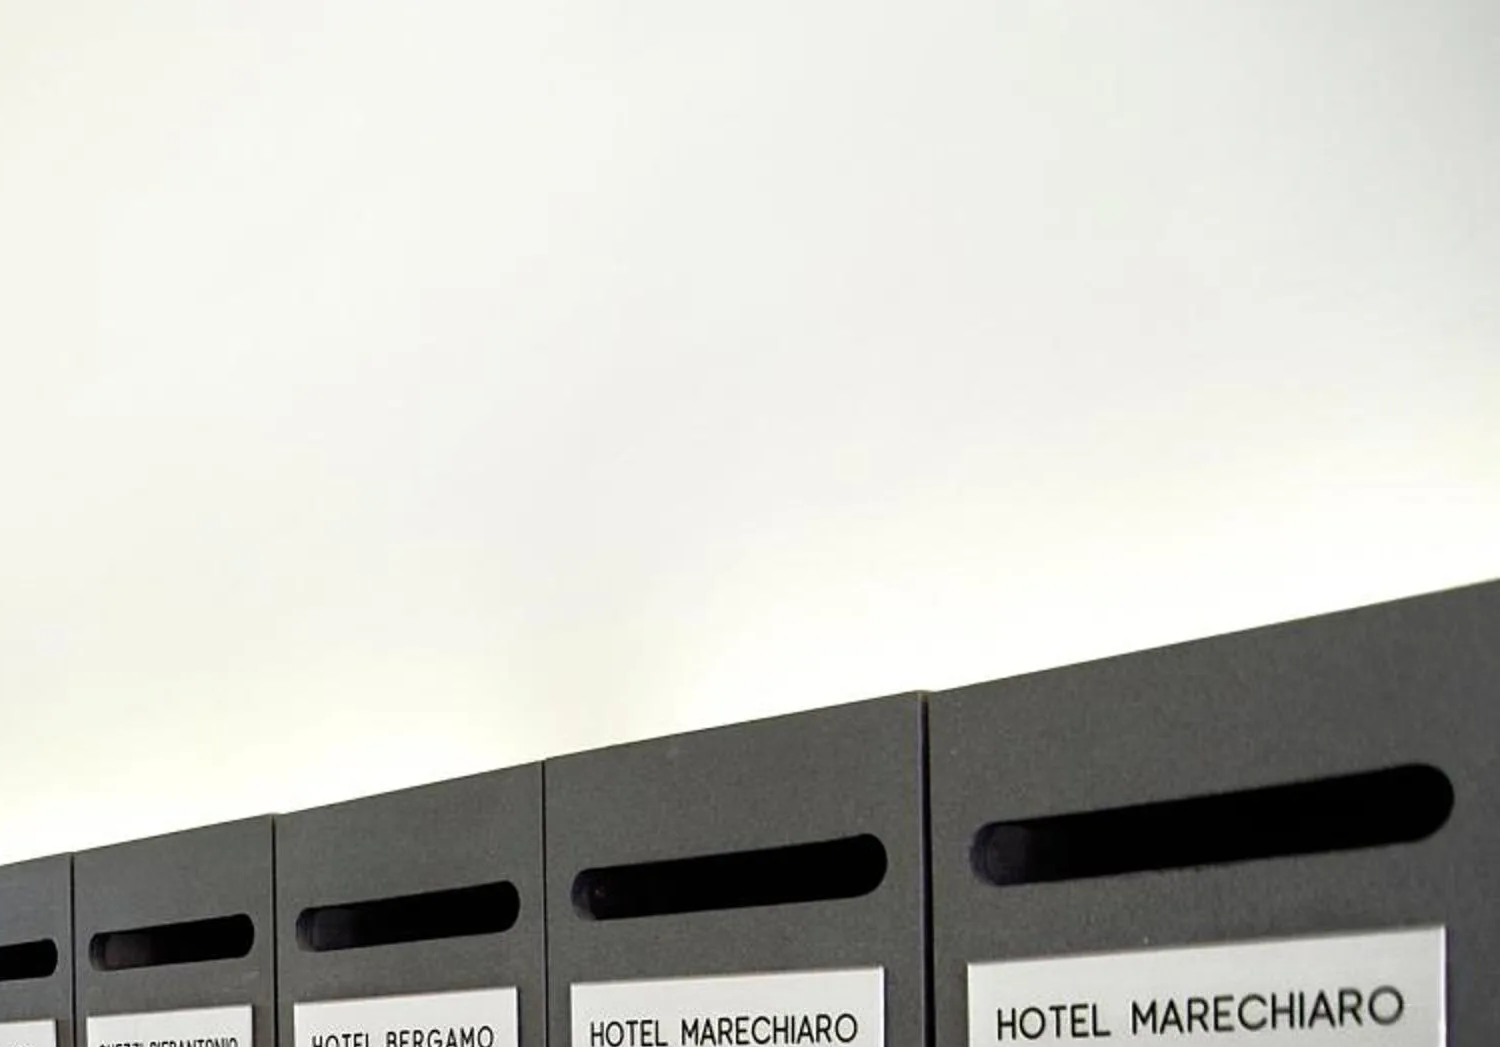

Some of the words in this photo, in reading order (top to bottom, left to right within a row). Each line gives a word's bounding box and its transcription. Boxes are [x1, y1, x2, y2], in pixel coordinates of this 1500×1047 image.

[590, 1019, 668, 1047] HOTEL
[680, 1013, 859, 1046] MARECHIARO
[997, 1004, 1112, 1041] HOTEL
[1131, 985, 1405, 1035] MARECHIARO
